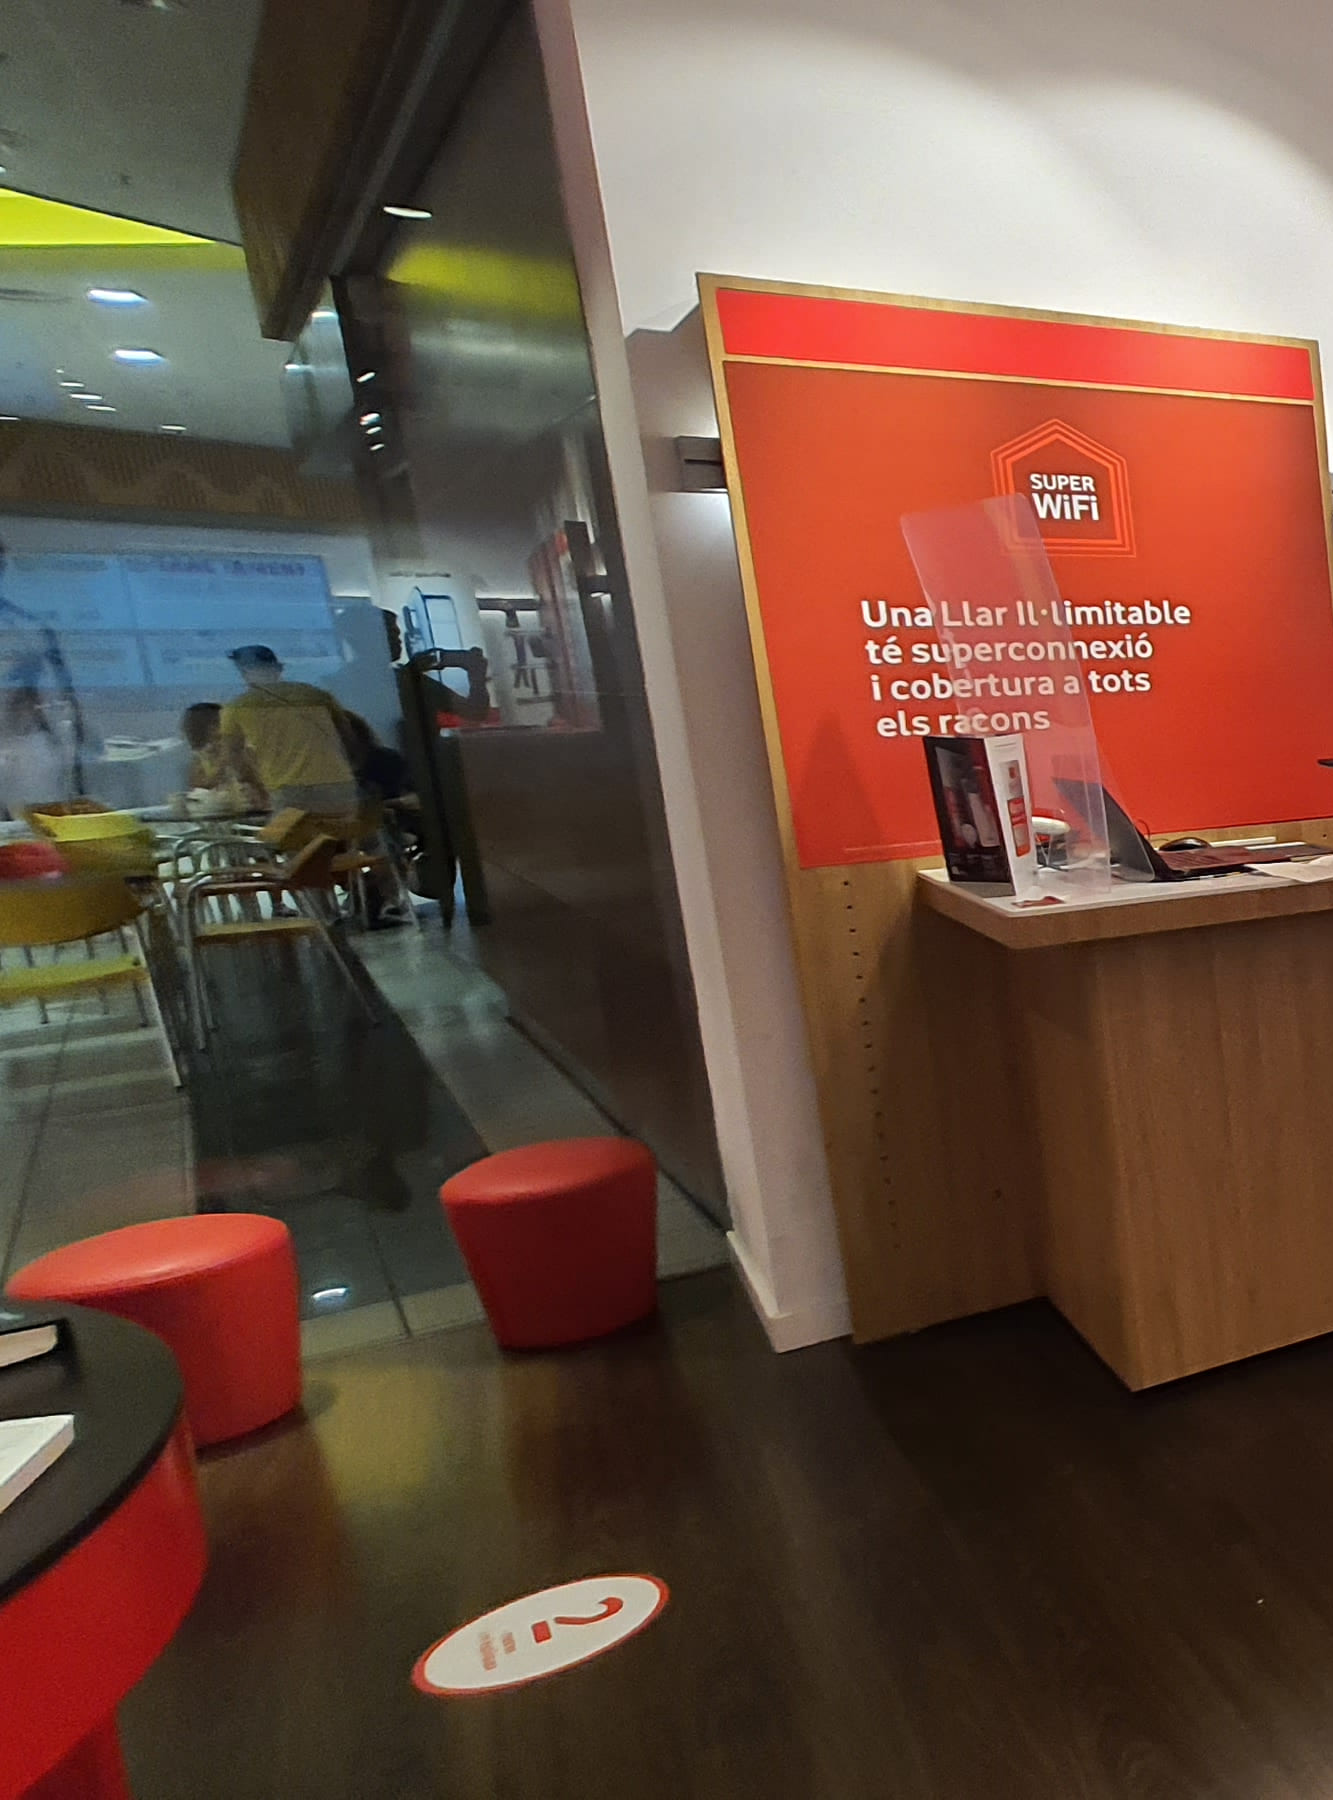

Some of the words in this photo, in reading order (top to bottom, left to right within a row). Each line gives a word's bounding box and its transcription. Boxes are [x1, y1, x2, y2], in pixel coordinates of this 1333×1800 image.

[1030, 473, 1096, 492] SUPER
[1031, 492, 1100, 521] WiFi
[861, 600, 934, 628] Una
[941, 600, 1008, 627] Llar
[864, 636, 903, 665] té
[911, 632, 1153, 669] superconnexió
[871, 675, 882, 701] i
[890, 672, 1055, 700] cobertura
[1063, 675, 1081, 694] a
[1088, 669, 1152, 693] tots
[876, 710, 931, 737] els
[938, 710, 1051, 735] racons
